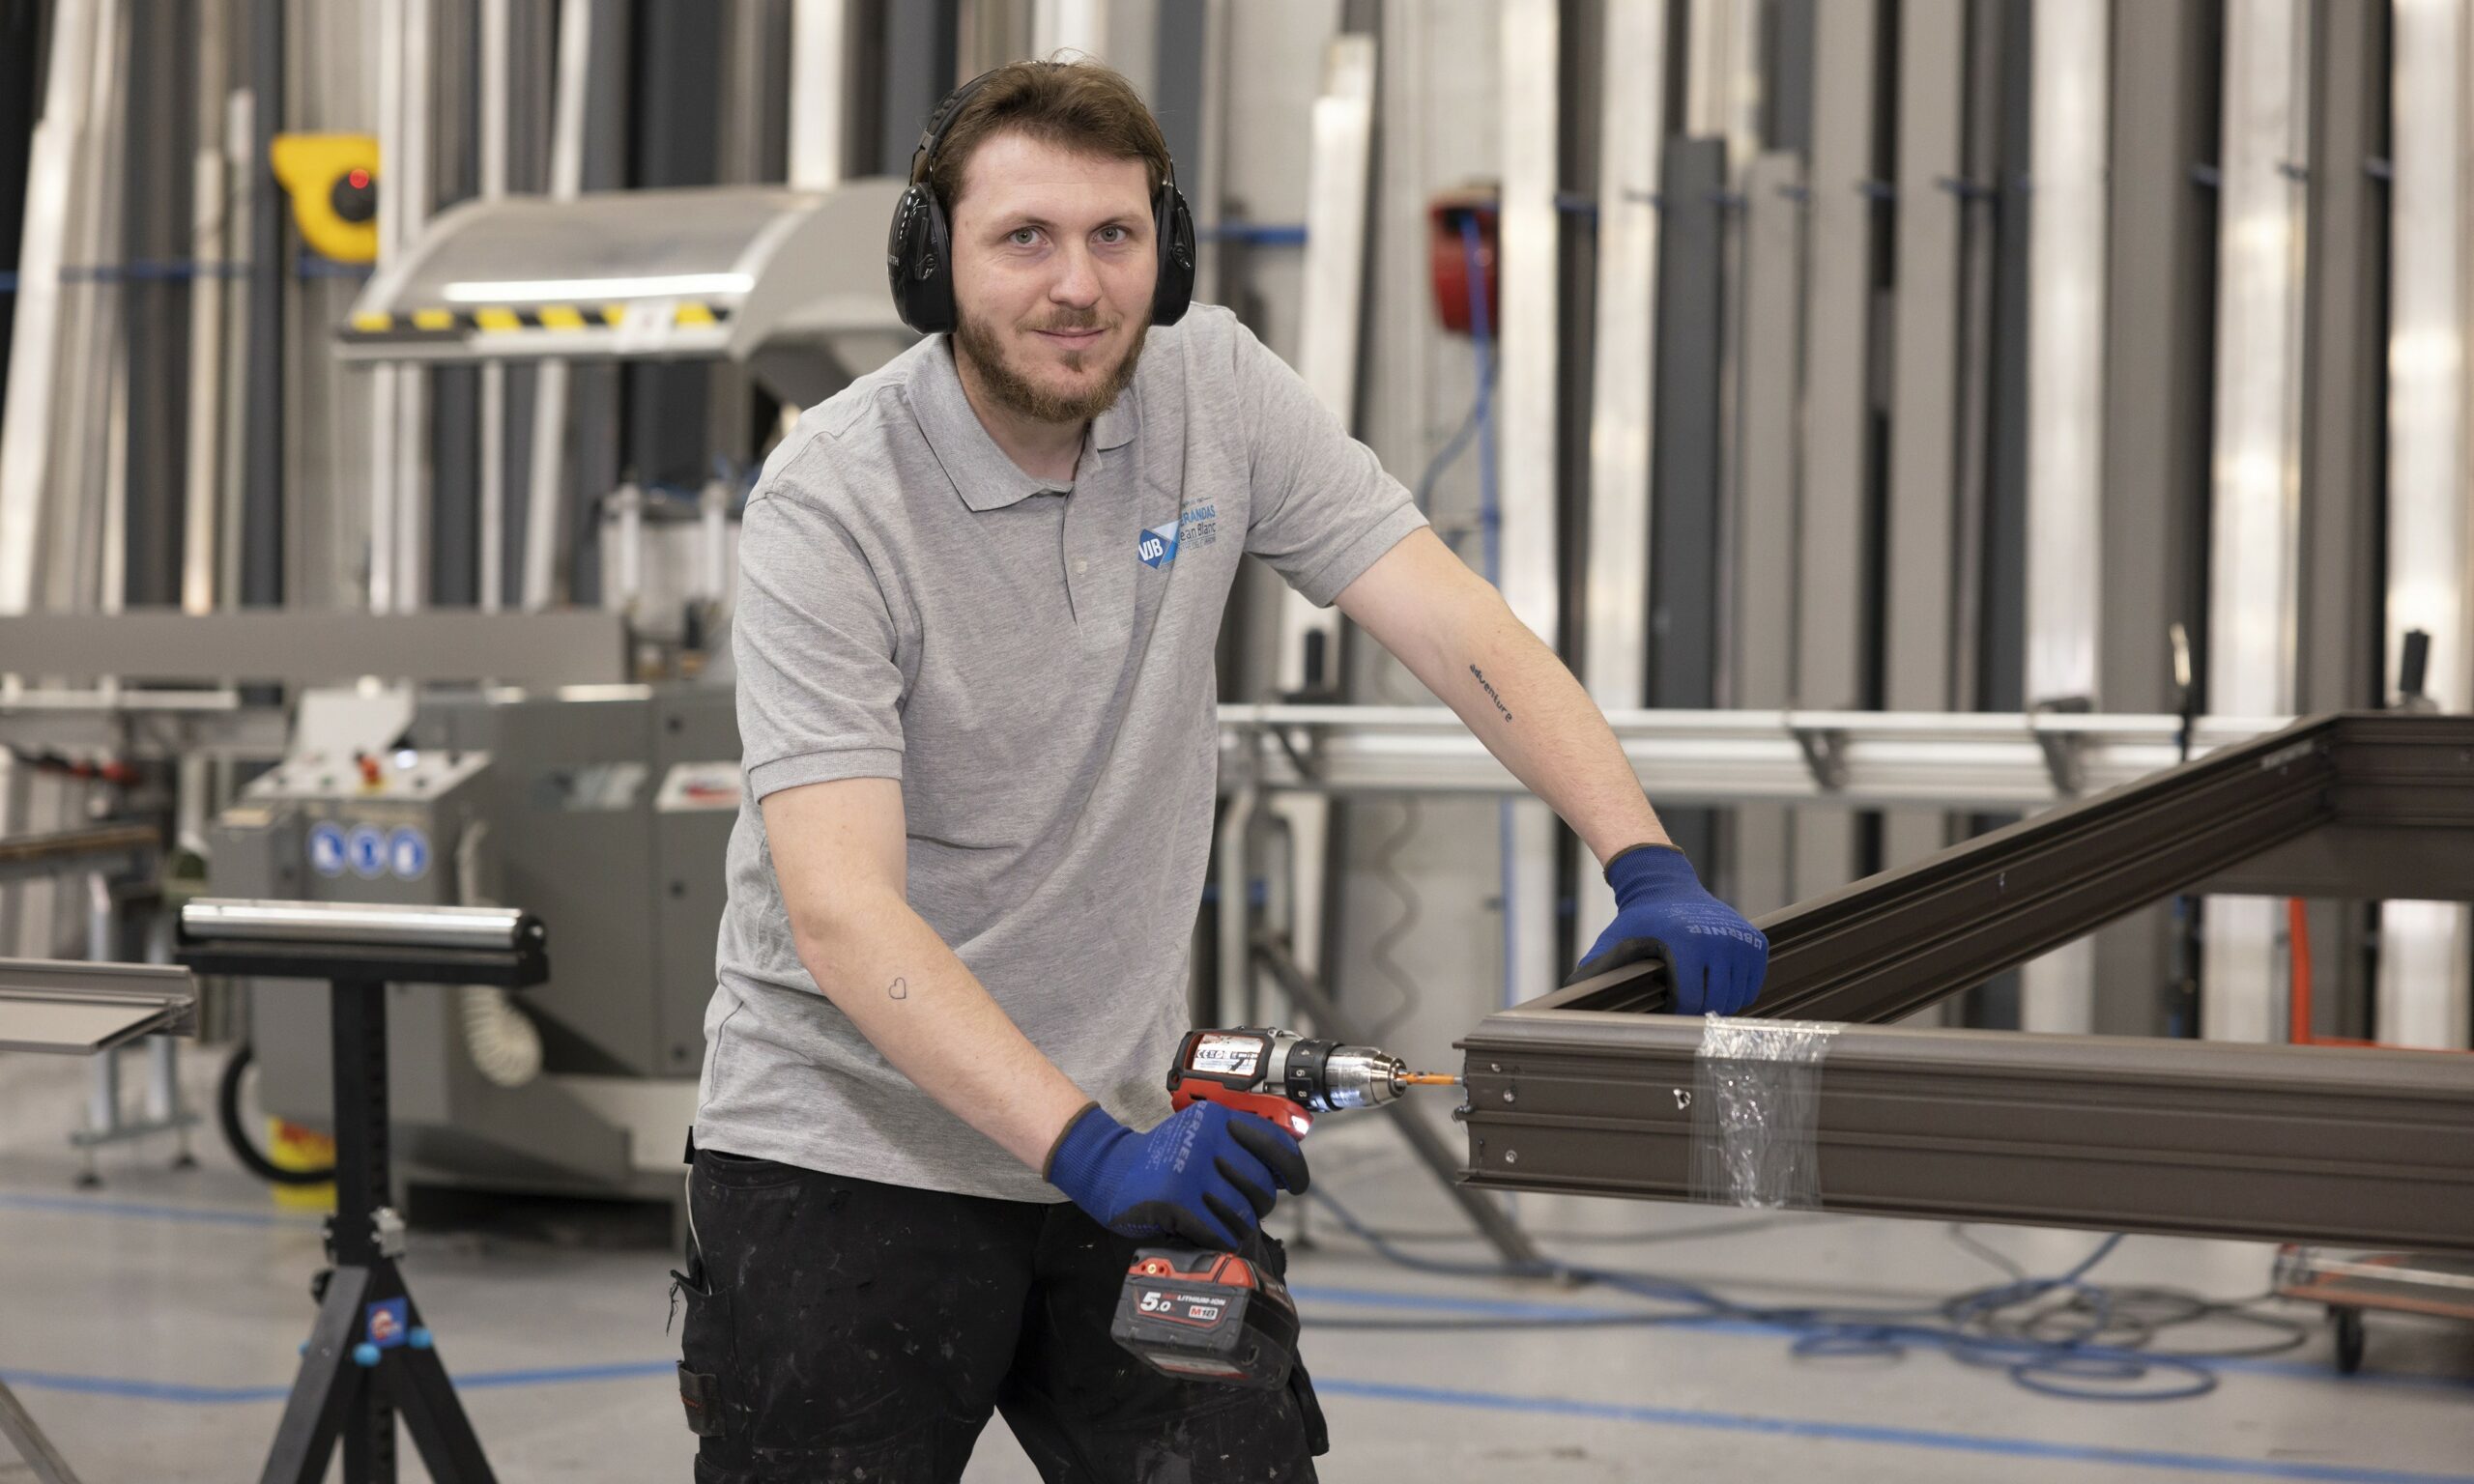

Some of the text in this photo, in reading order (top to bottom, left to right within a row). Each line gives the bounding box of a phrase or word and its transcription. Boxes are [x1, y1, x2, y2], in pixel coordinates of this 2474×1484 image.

[1197, 522, 1216, 537] Blanc
[1138, 538, 1164, 561] VJB
[1469, 664, 1512, 723] adventure
[1685, 925, 1754, 945] BERNER
[1173, 1100, 1208, 1174] BERNER
[1139, 1291, 1171, 1312] 5.0
[1190, 1307, 1217, 1317] M18
